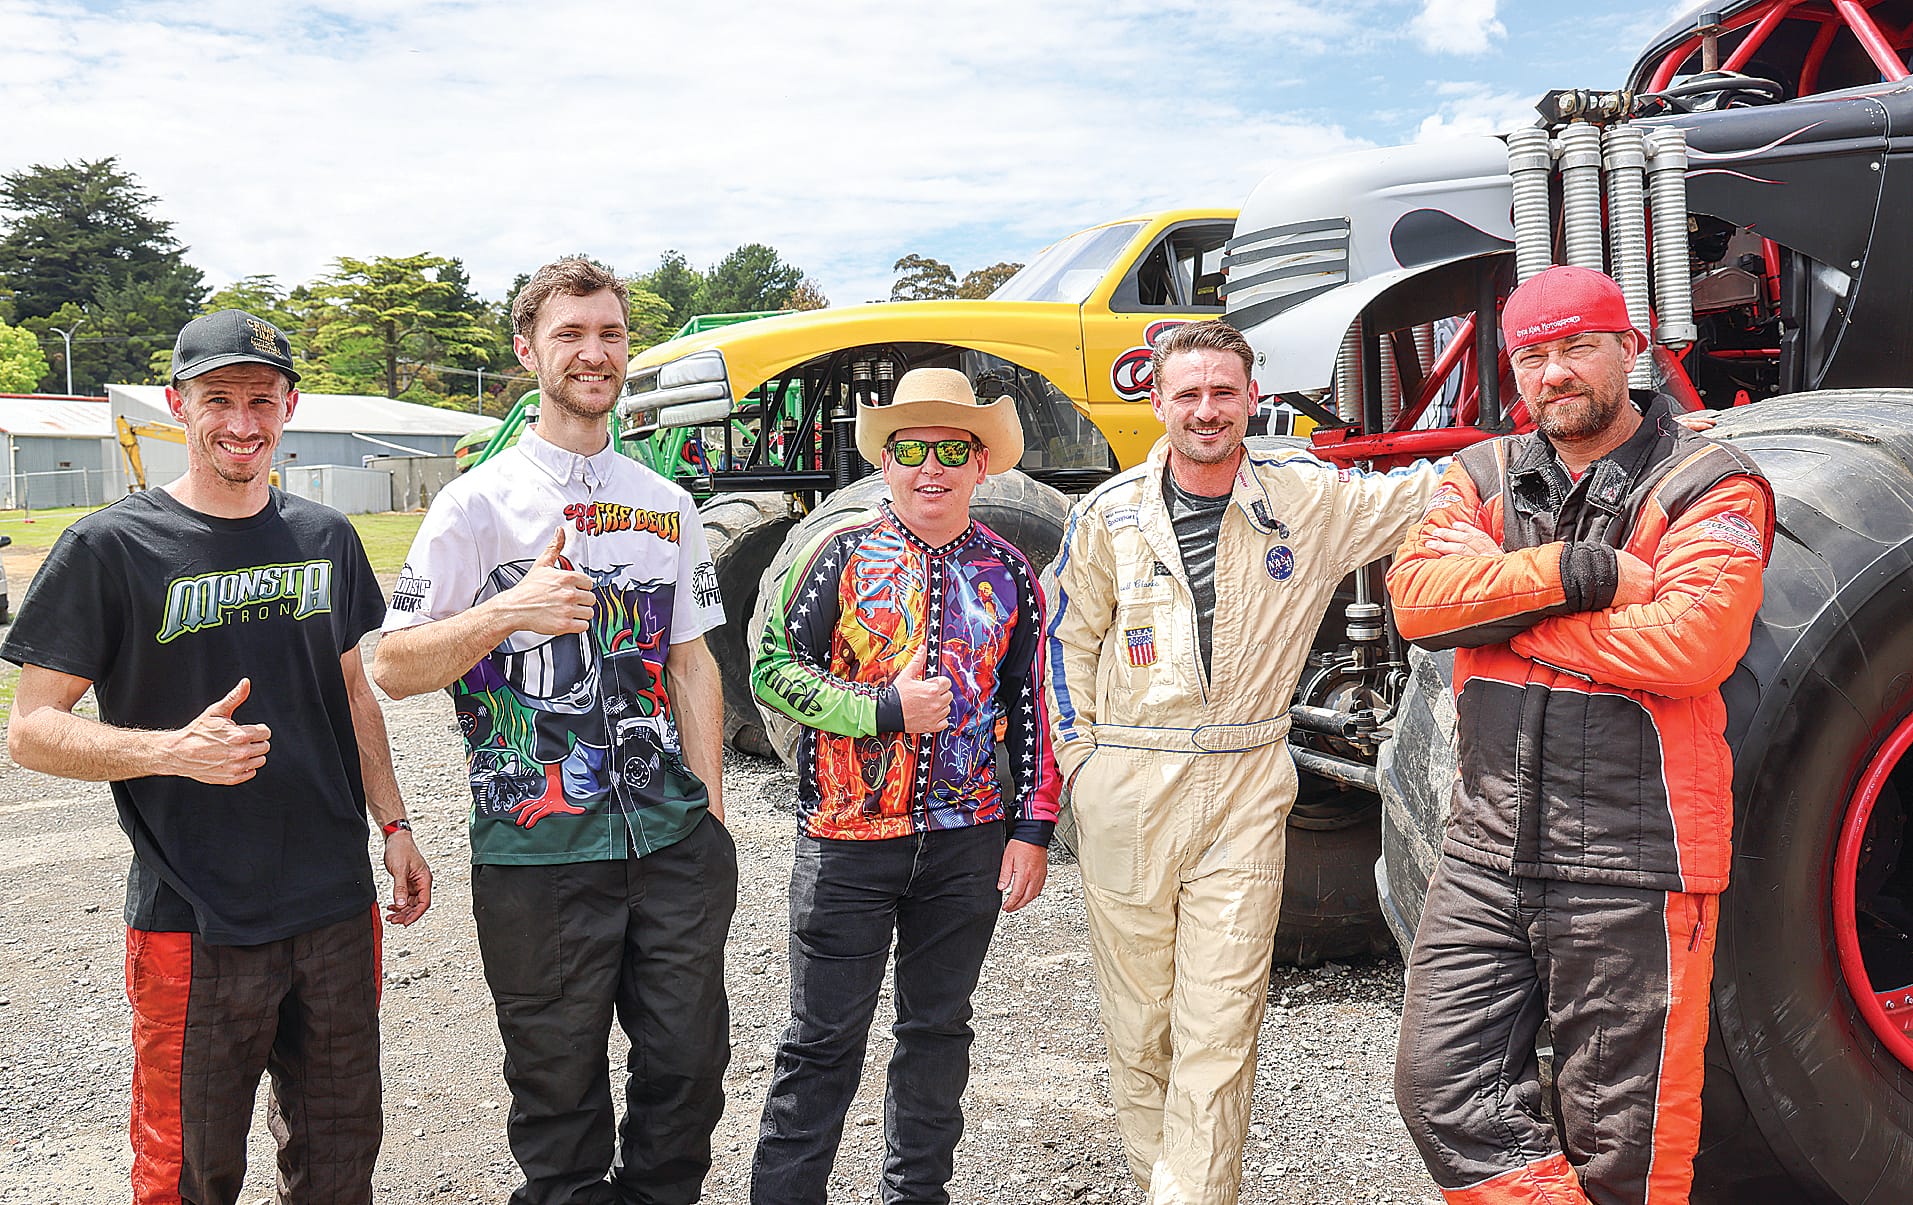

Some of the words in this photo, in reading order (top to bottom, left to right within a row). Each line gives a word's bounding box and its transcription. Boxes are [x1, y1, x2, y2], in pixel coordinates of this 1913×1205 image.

[593, 501, 633, 536] THE
[1268, 557, 1293, 570] NASA
[225, 602, 290, 625] TRON
